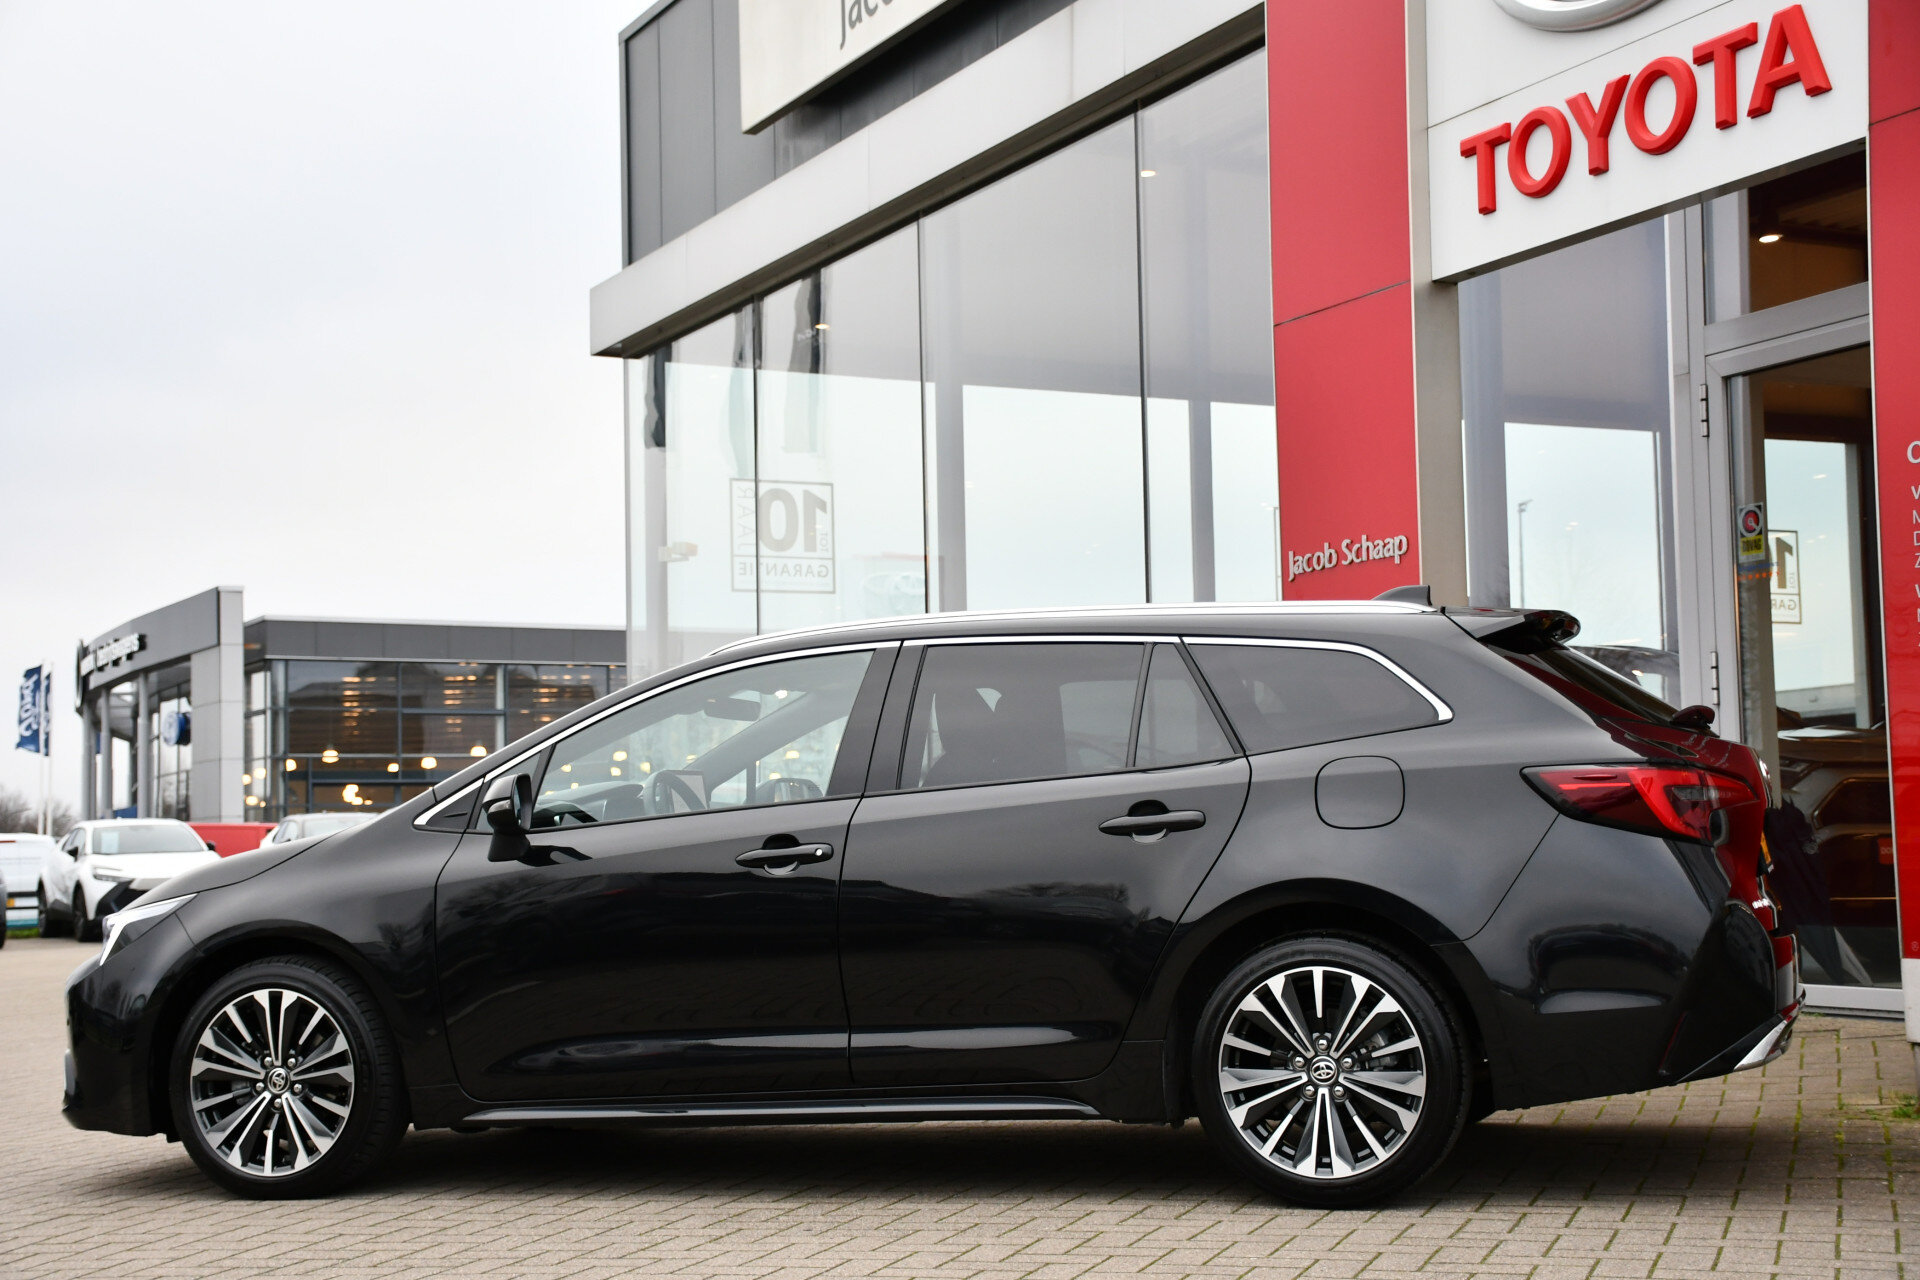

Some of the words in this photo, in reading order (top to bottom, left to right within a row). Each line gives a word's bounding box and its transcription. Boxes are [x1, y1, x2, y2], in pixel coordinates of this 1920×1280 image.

[1460, 4, 1832, 215] TOYOTA
[1288, 542, 1338, 582] Jacob
[1341, 534, 1408, 565] Schaap
